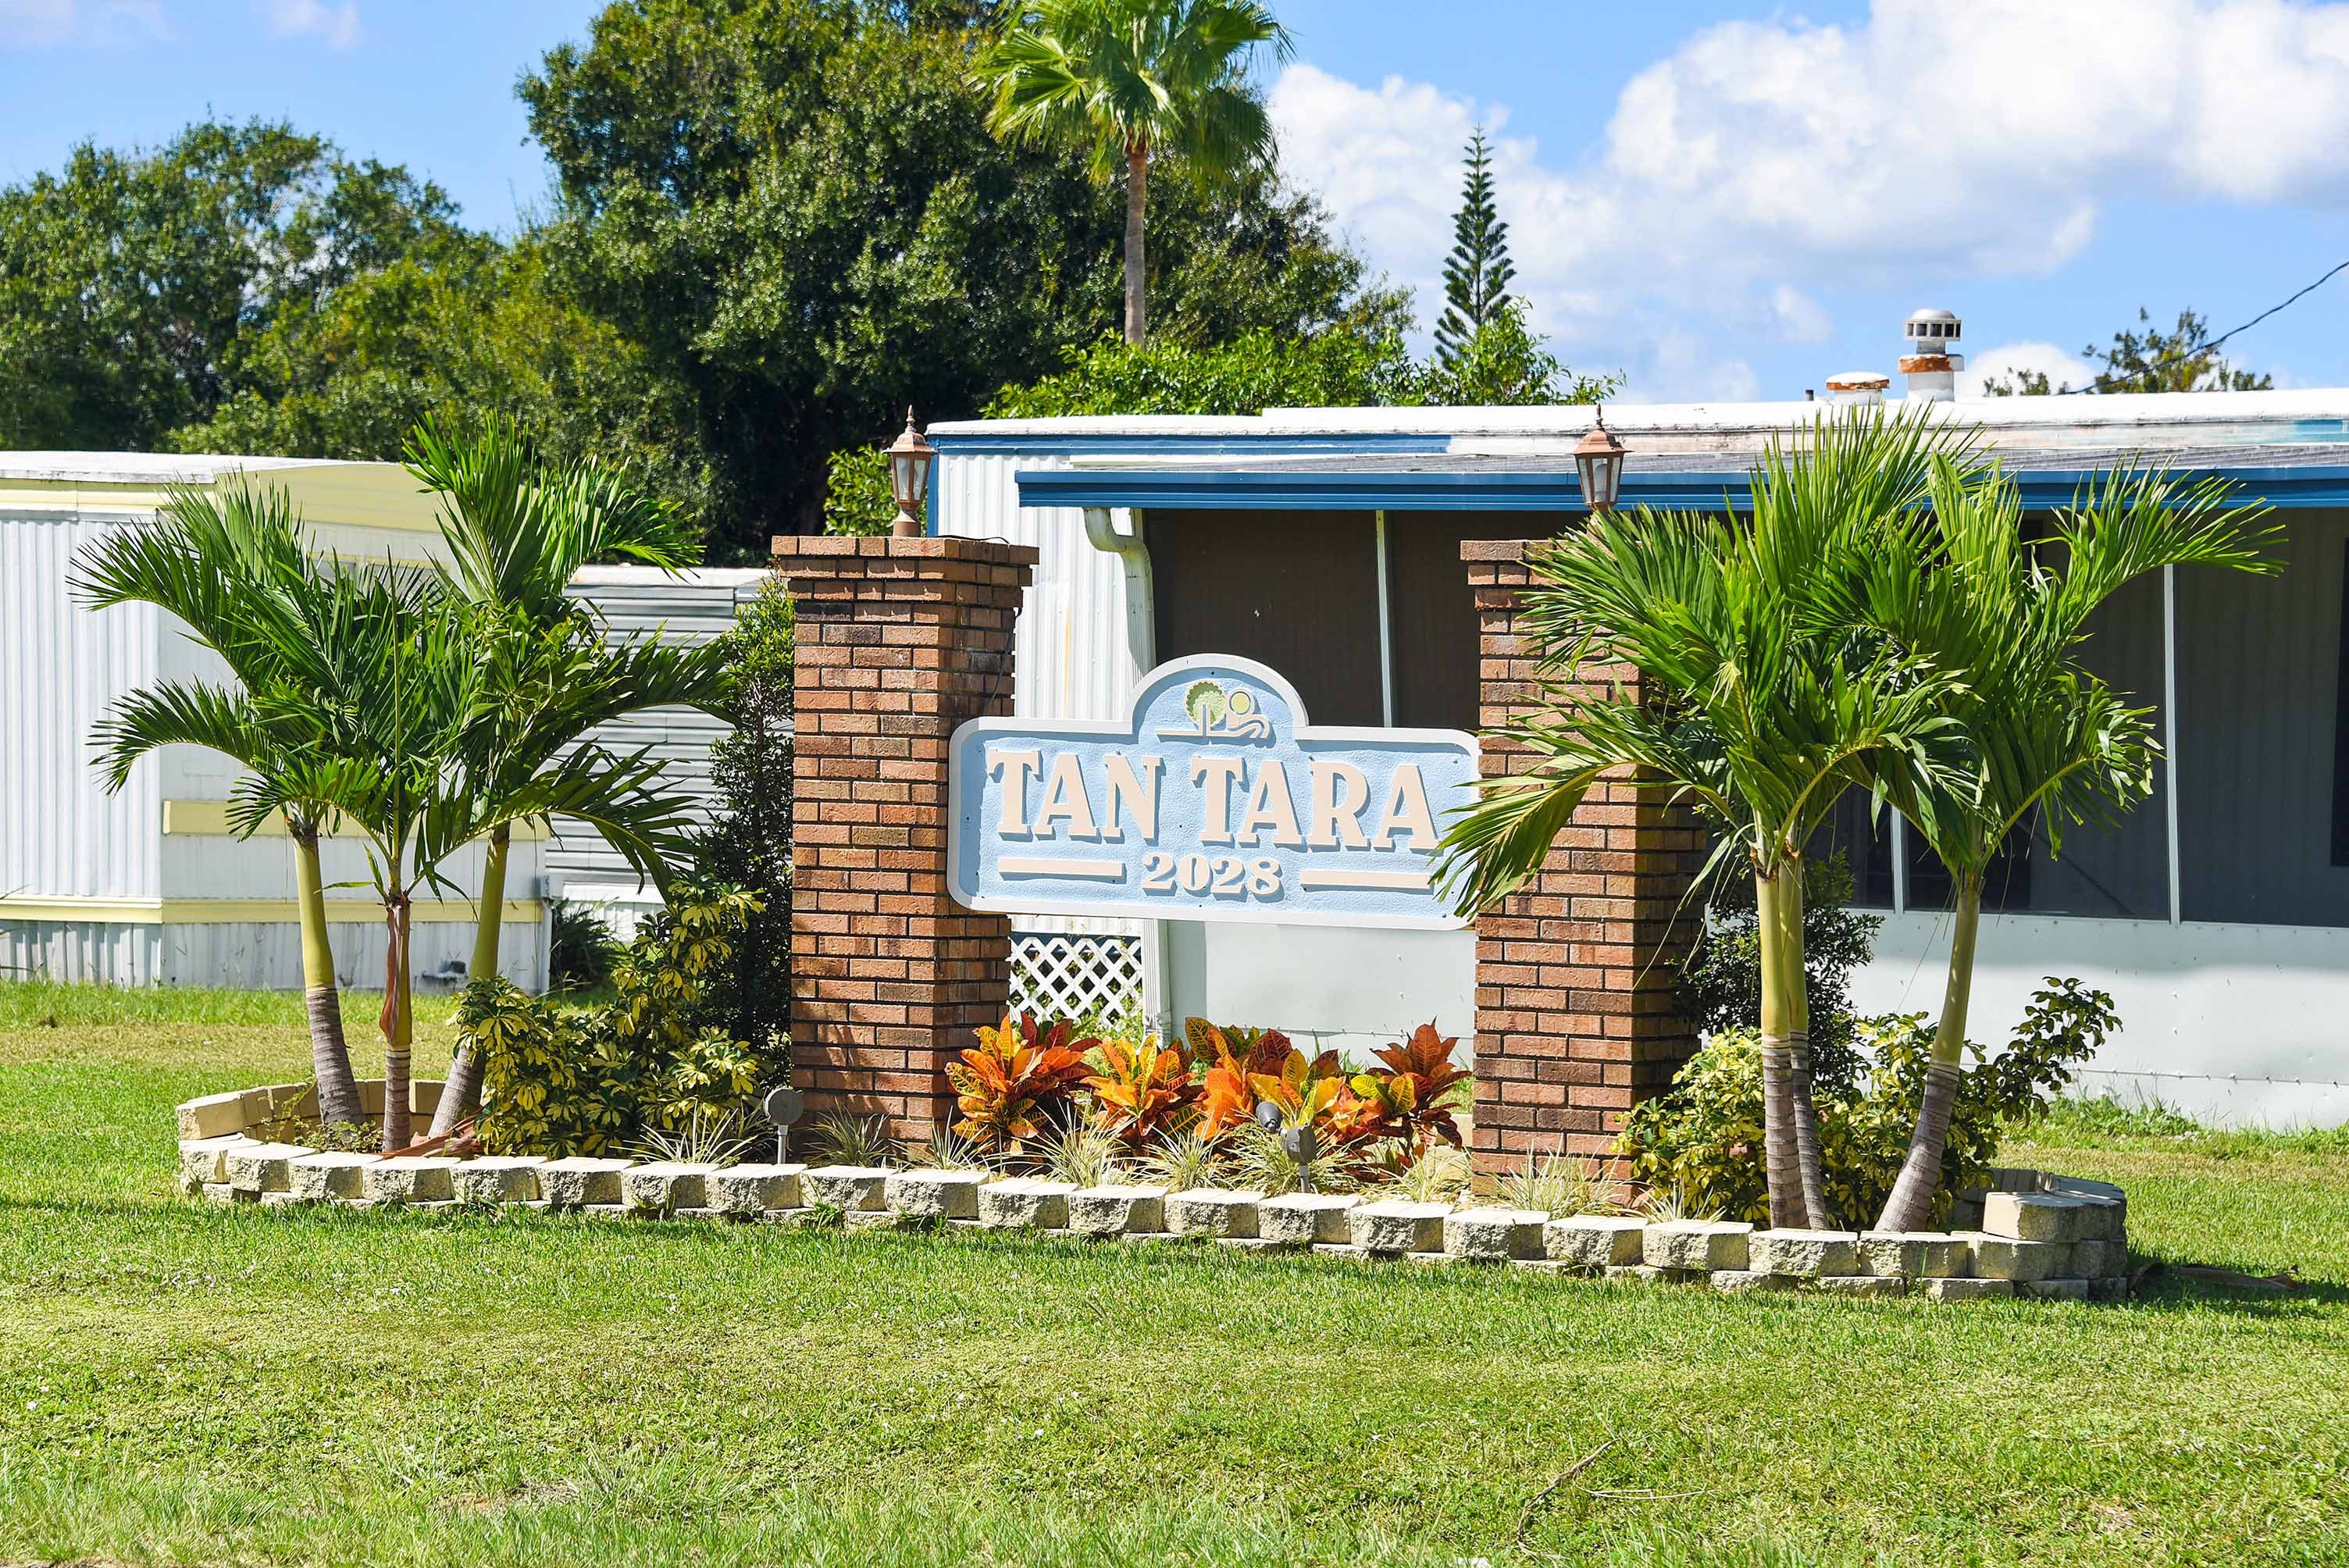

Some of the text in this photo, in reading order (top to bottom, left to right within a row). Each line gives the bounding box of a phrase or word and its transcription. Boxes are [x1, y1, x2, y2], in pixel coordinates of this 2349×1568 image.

[988, 749, 1440, 850] TAN TARA
[1142, 854, 1281, 896] 2028
